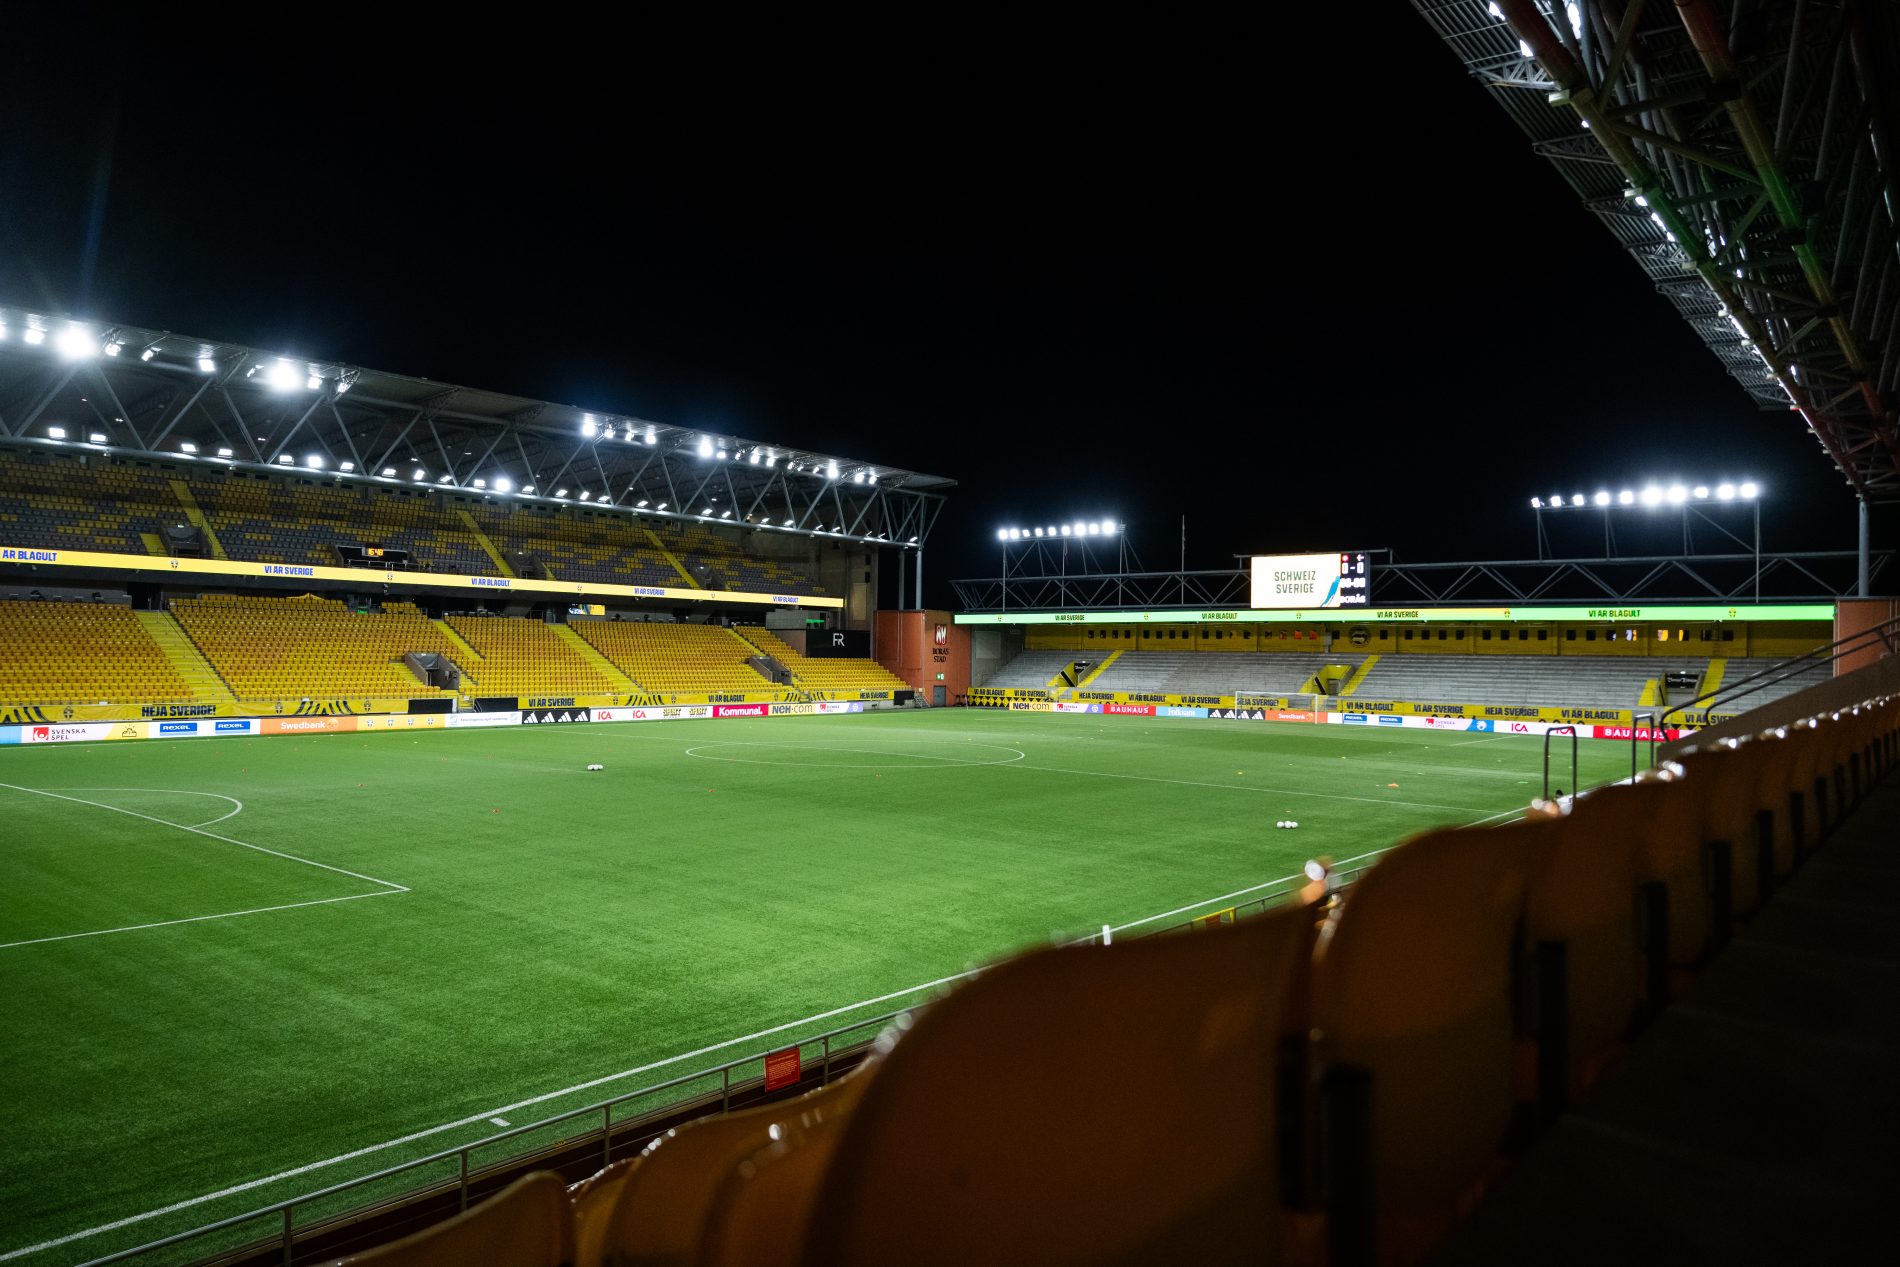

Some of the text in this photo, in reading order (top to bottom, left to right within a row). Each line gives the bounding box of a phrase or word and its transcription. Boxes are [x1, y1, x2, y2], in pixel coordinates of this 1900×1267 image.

[1274, 570, 1316, 582] SCHWEIZ
[1276, 583, 1314, 594] SVERIGE
[528, 698, 536, 708] VI
[548, 697, 575, 708] SVERIGE
[142, 705, 216, 717] HEJA SVERIGE!
[1110, 706, 1149, 714] BAUHAUS
[1414, 704, 1422, 712] VI
[1433, 704, 1464, 714] SVERIGE
[1484, 706, 1539, 716] HEJA SVERIGE!
[1561, 710, 1571, 718] VI
[598, 710, 612, 720] ICA
[632, 710, 646, 719] ICA
[280, 722, 326, 730] Swedbank
[1511, 723, 1528, 732] ICA
